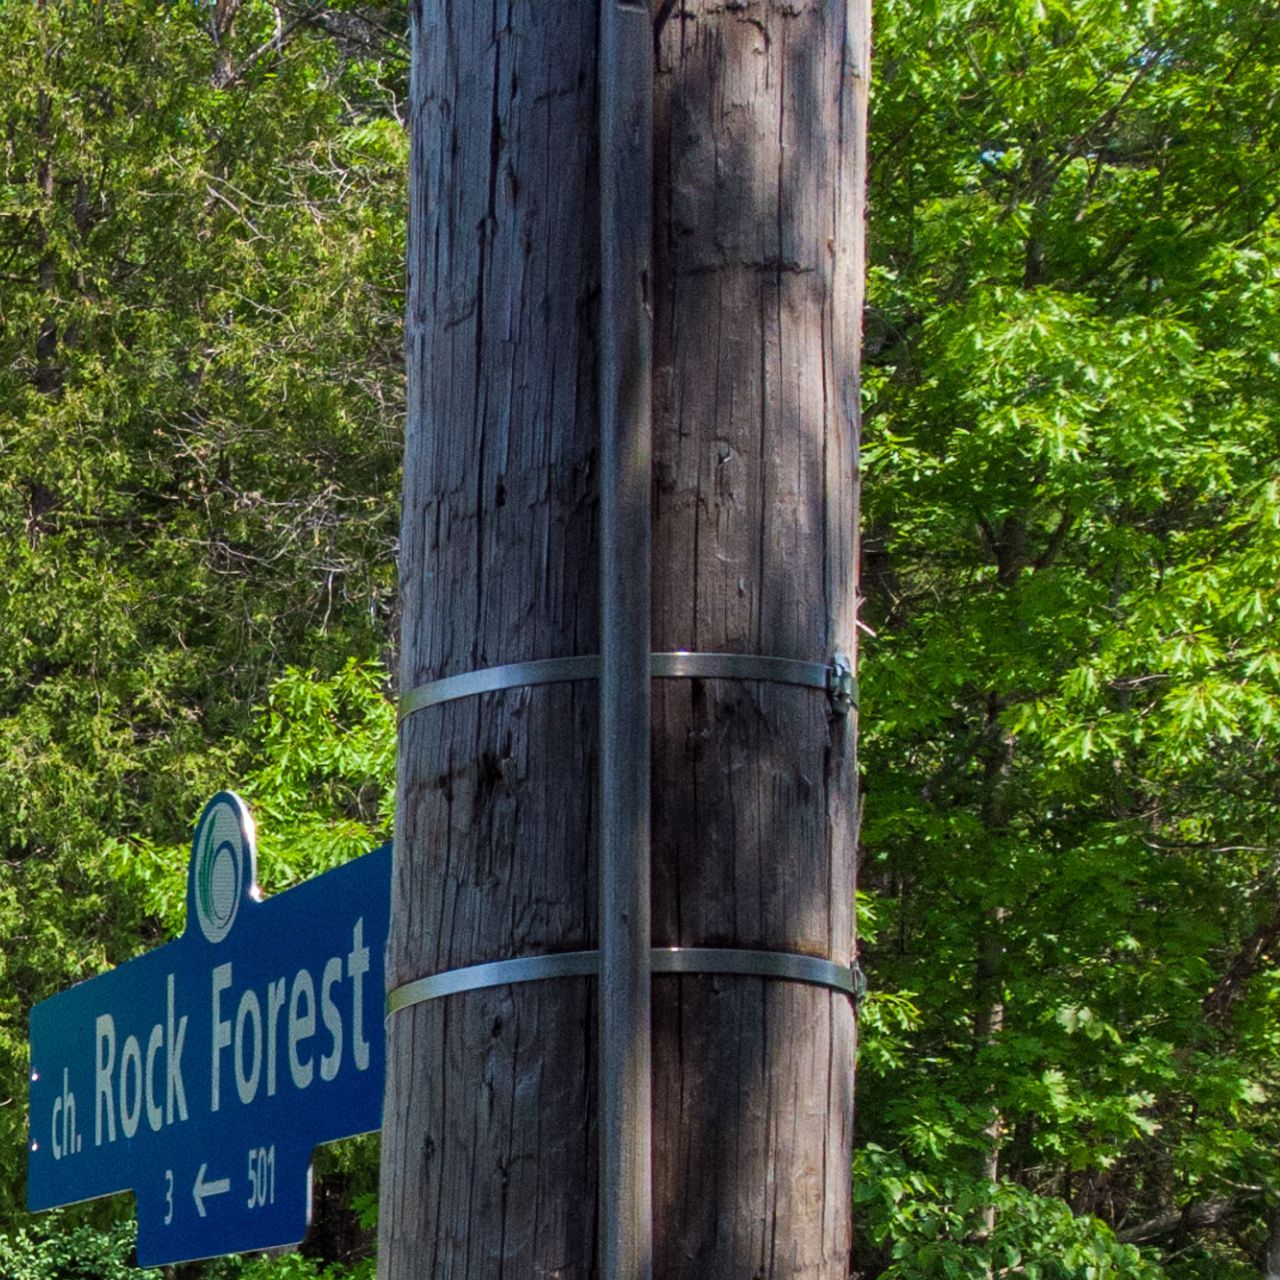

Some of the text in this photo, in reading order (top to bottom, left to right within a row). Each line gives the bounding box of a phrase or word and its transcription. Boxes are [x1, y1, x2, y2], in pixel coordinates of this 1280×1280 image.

[51, 916, 371, 1161] ch. Rock Forest
[164, 1143, 276, 1226] 3 501
